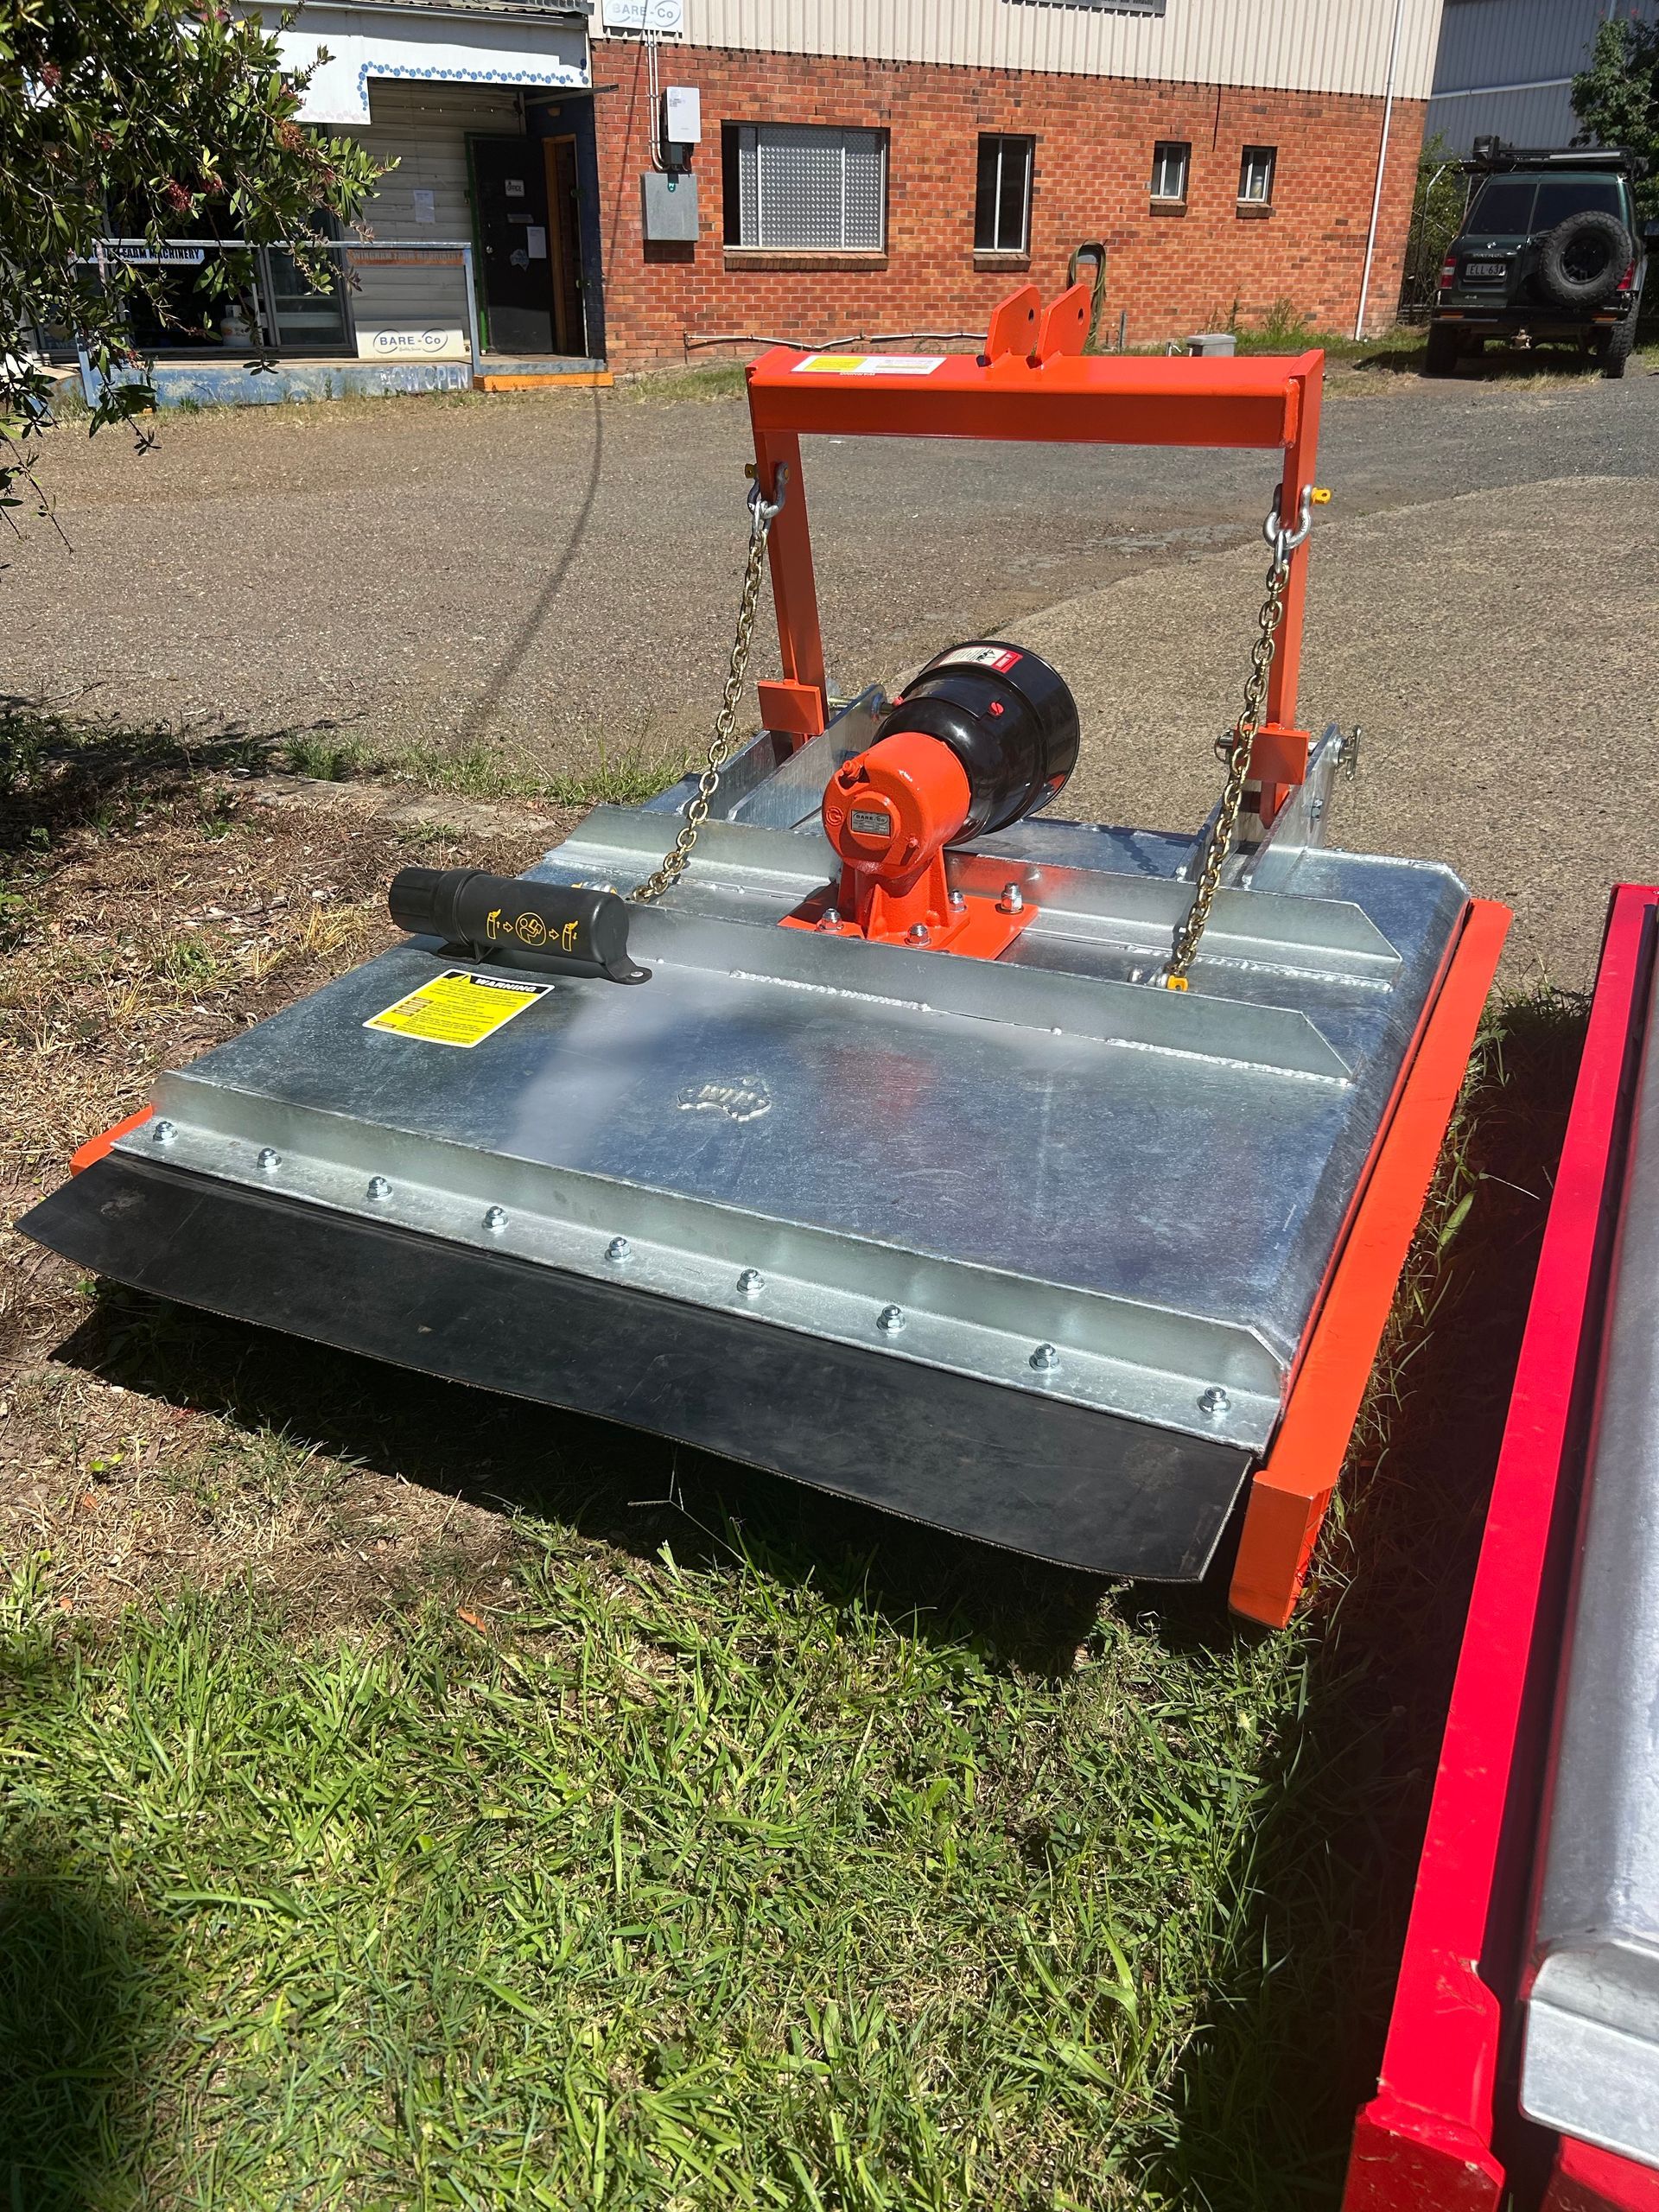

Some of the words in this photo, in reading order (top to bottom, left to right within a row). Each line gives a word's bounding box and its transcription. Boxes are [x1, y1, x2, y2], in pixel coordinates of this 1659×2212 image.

[149, 248, 200, 259] MACHINERY
[380, 366, 420, 391] NOW
[424, 365, 468, 391] OPEN
[474, 978, 537, 993] WARNING
